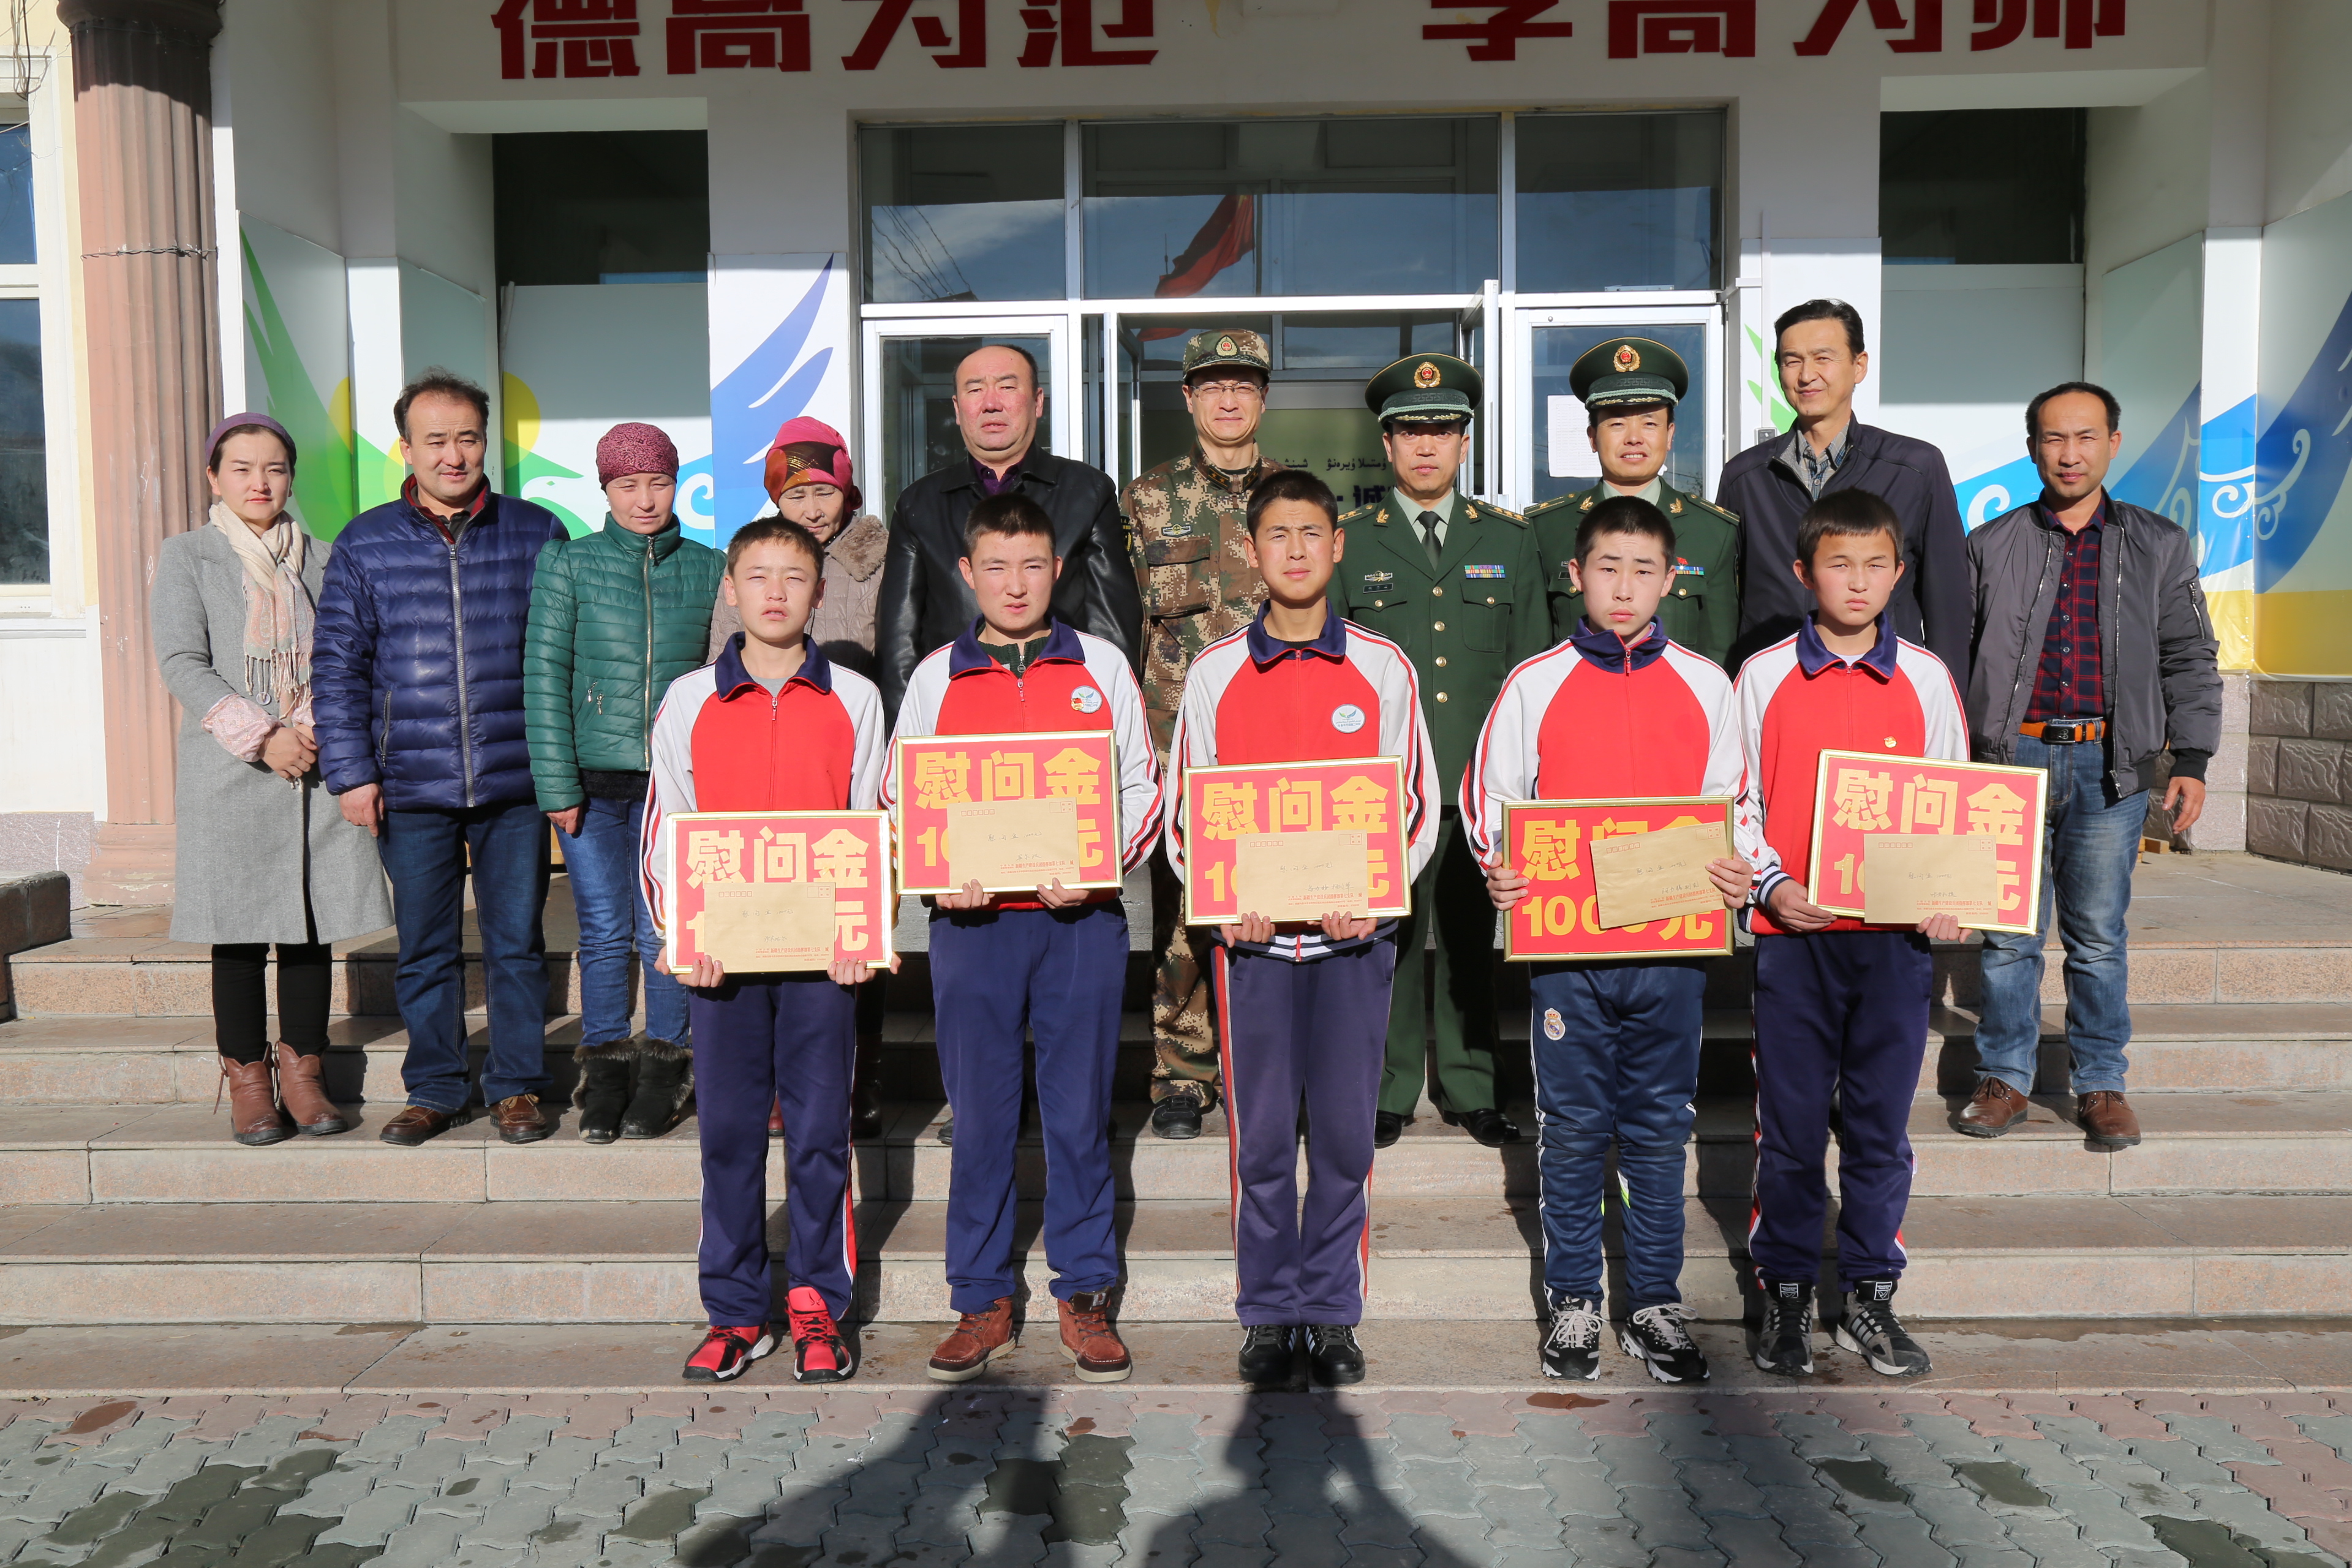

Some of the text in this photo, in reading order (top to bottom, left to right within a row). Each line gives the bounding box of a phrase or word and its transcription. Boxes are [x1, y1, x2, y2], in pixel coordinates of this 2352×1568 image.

[913, 748, 1101, 810] 慰问金
[1201, 776, 1389, 840] 慰问金
[1832, 768, 2027, 845] 慰问金
[686, 826, 869, 889] 慰问金
[1522, 895, 1713, 941] 100元
